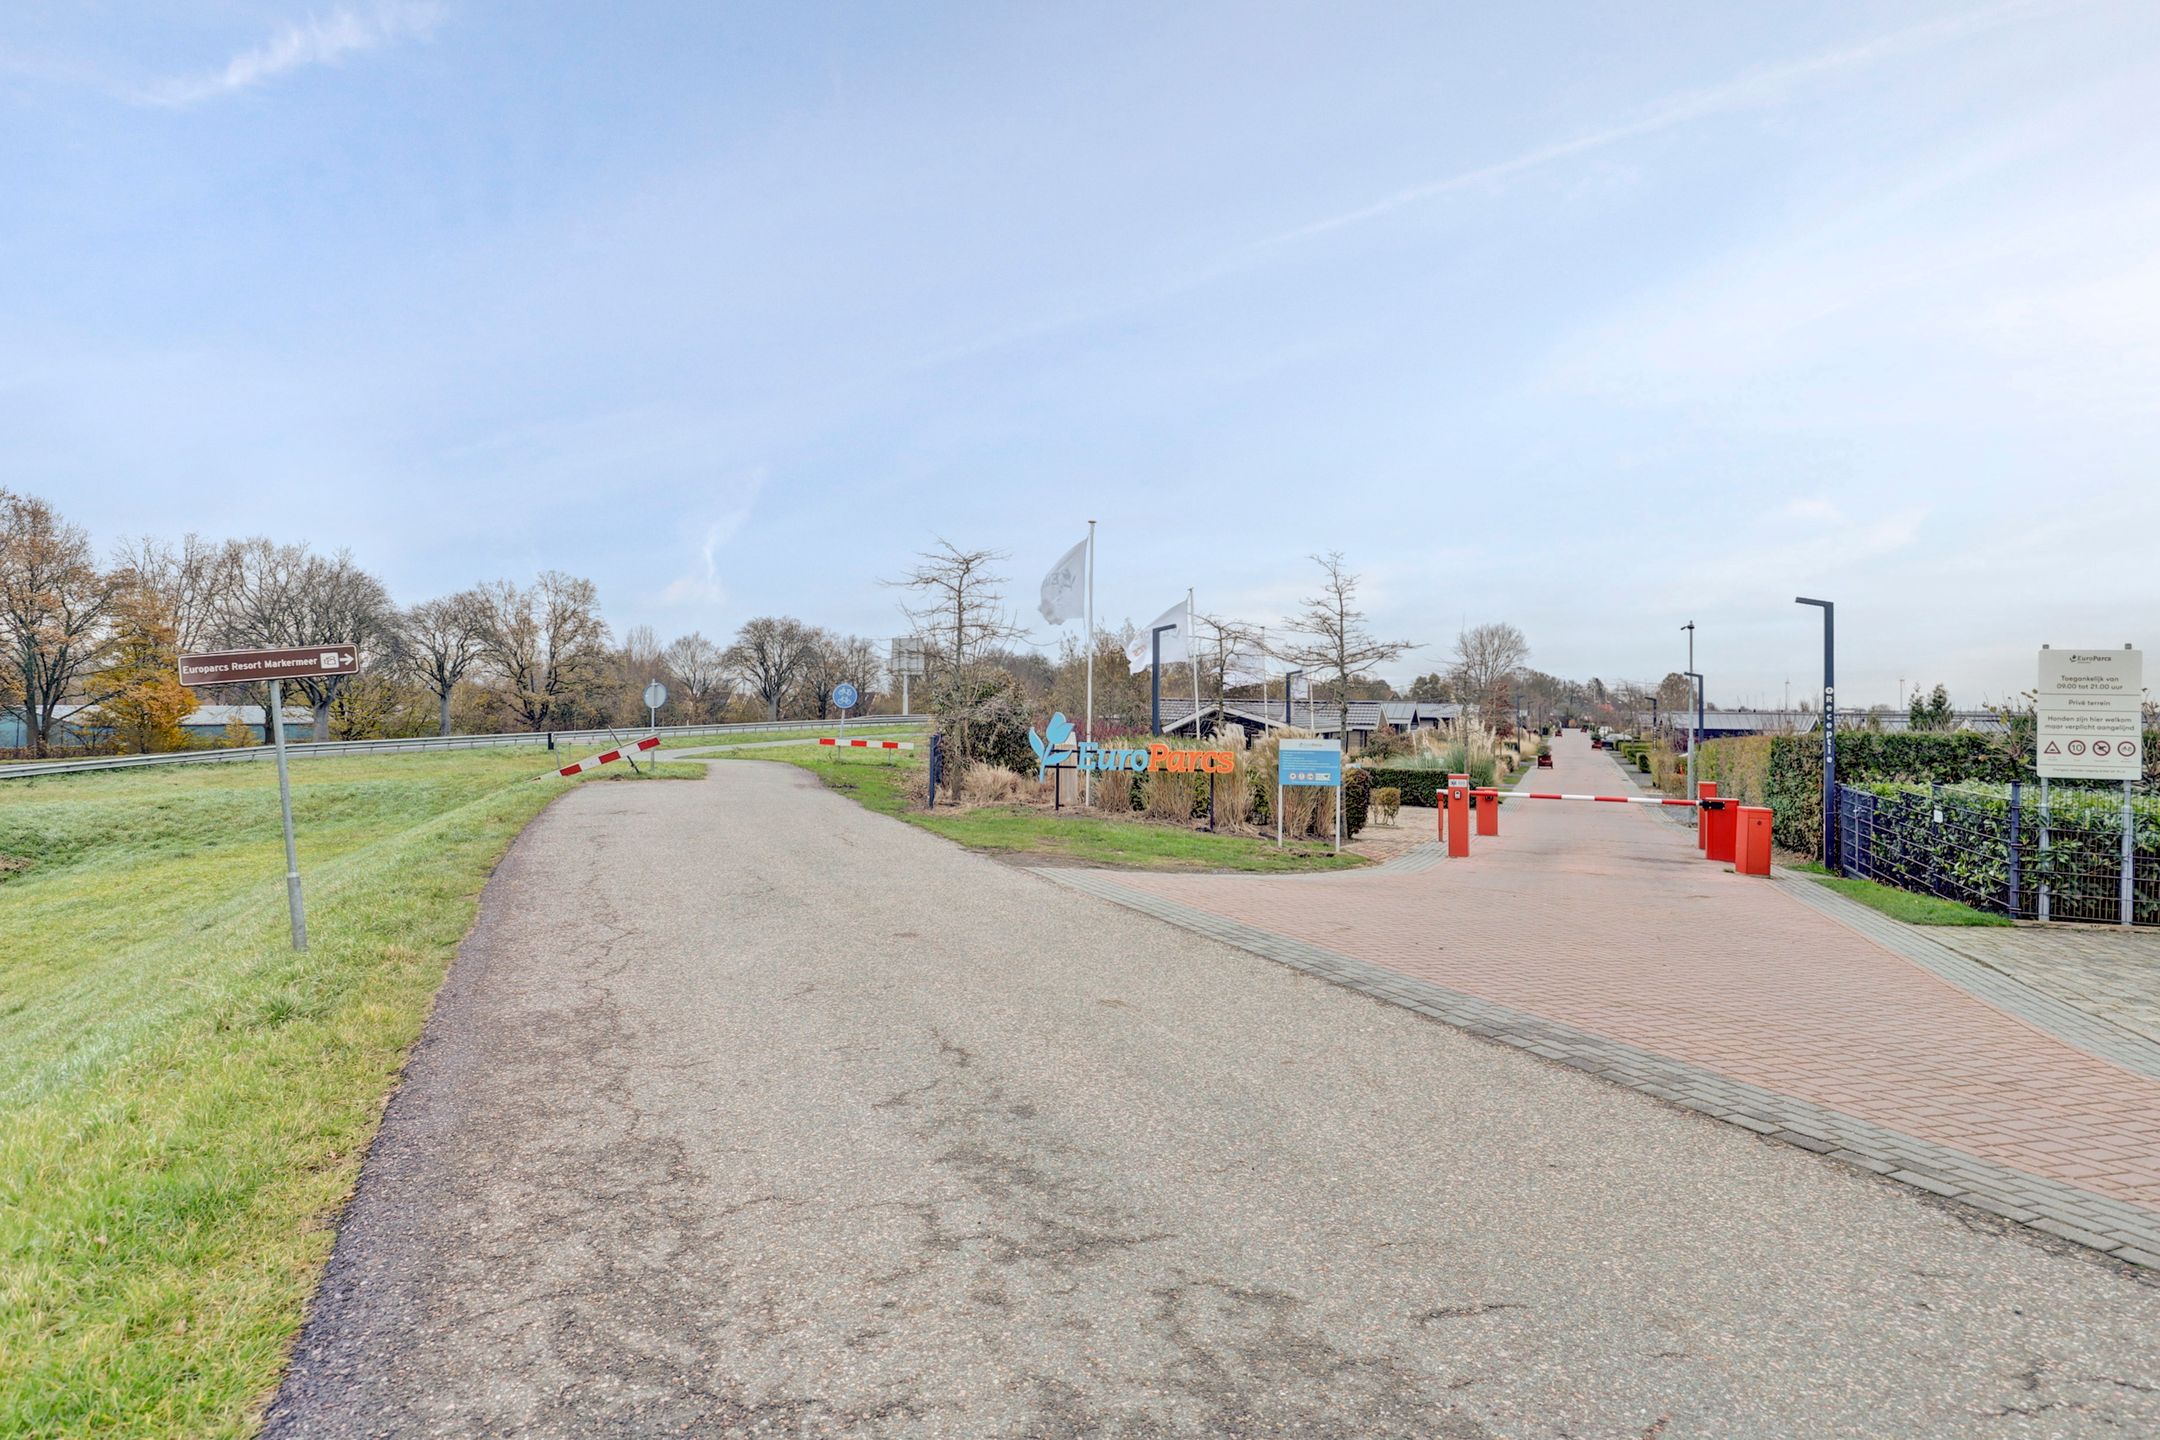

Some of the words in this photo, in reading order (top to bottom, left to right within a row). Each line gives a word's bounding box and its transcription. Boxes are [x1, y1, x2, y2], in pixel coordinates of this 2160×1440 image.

[182, 664, 229, 675] Europarcs
[231, 661, 262, 671] Resort
[264, 658, 318, 669] Markermeer
[2072, 744, 2083, 752] 10
[1077, 741, 1235, 774] EuroParcs
